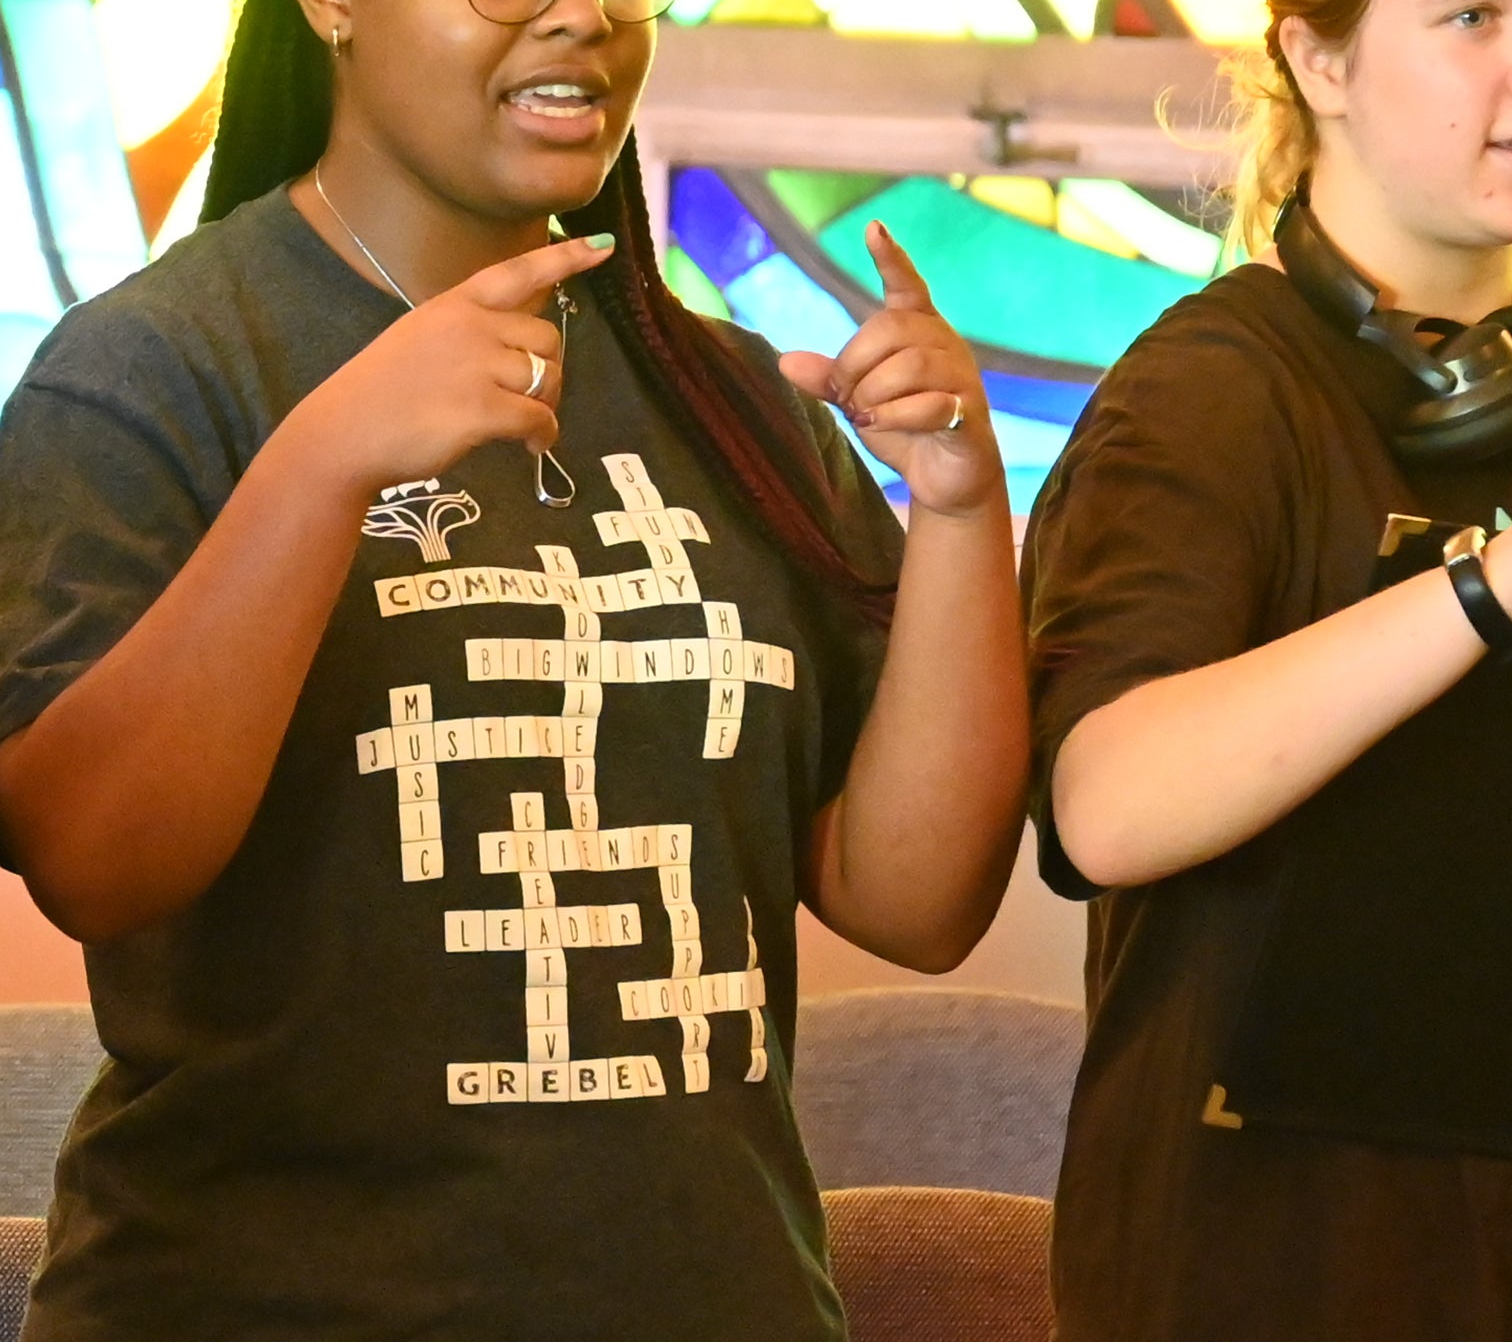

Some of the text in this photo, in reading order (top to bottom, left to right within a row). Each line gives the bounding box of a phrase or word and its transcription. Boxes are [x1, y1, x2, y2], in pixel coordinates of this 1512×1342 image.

[609, 514, 699, 537] FUN
[621, 461, 685, 598] STUDY
[388, 573, 686, 607] COMMUNITY
[717, 609, 734, 753] HOME
[553, 551, 590, 866] KNOWLEDGE
[370, 725, 583, 767] JUSTICE
[404, 693, 430, 877] MUSIC
[497, 834, 679, 868] FRIENDS
[461, 914, 631, 947] LEADER
[524, 800, 560, 1093] CREATIVE
[670, 834, 701, 1087] SUPPORT
[632, 981, 760, 1017] COOKI
[457, 1057, 658, 1096] GREBEL
